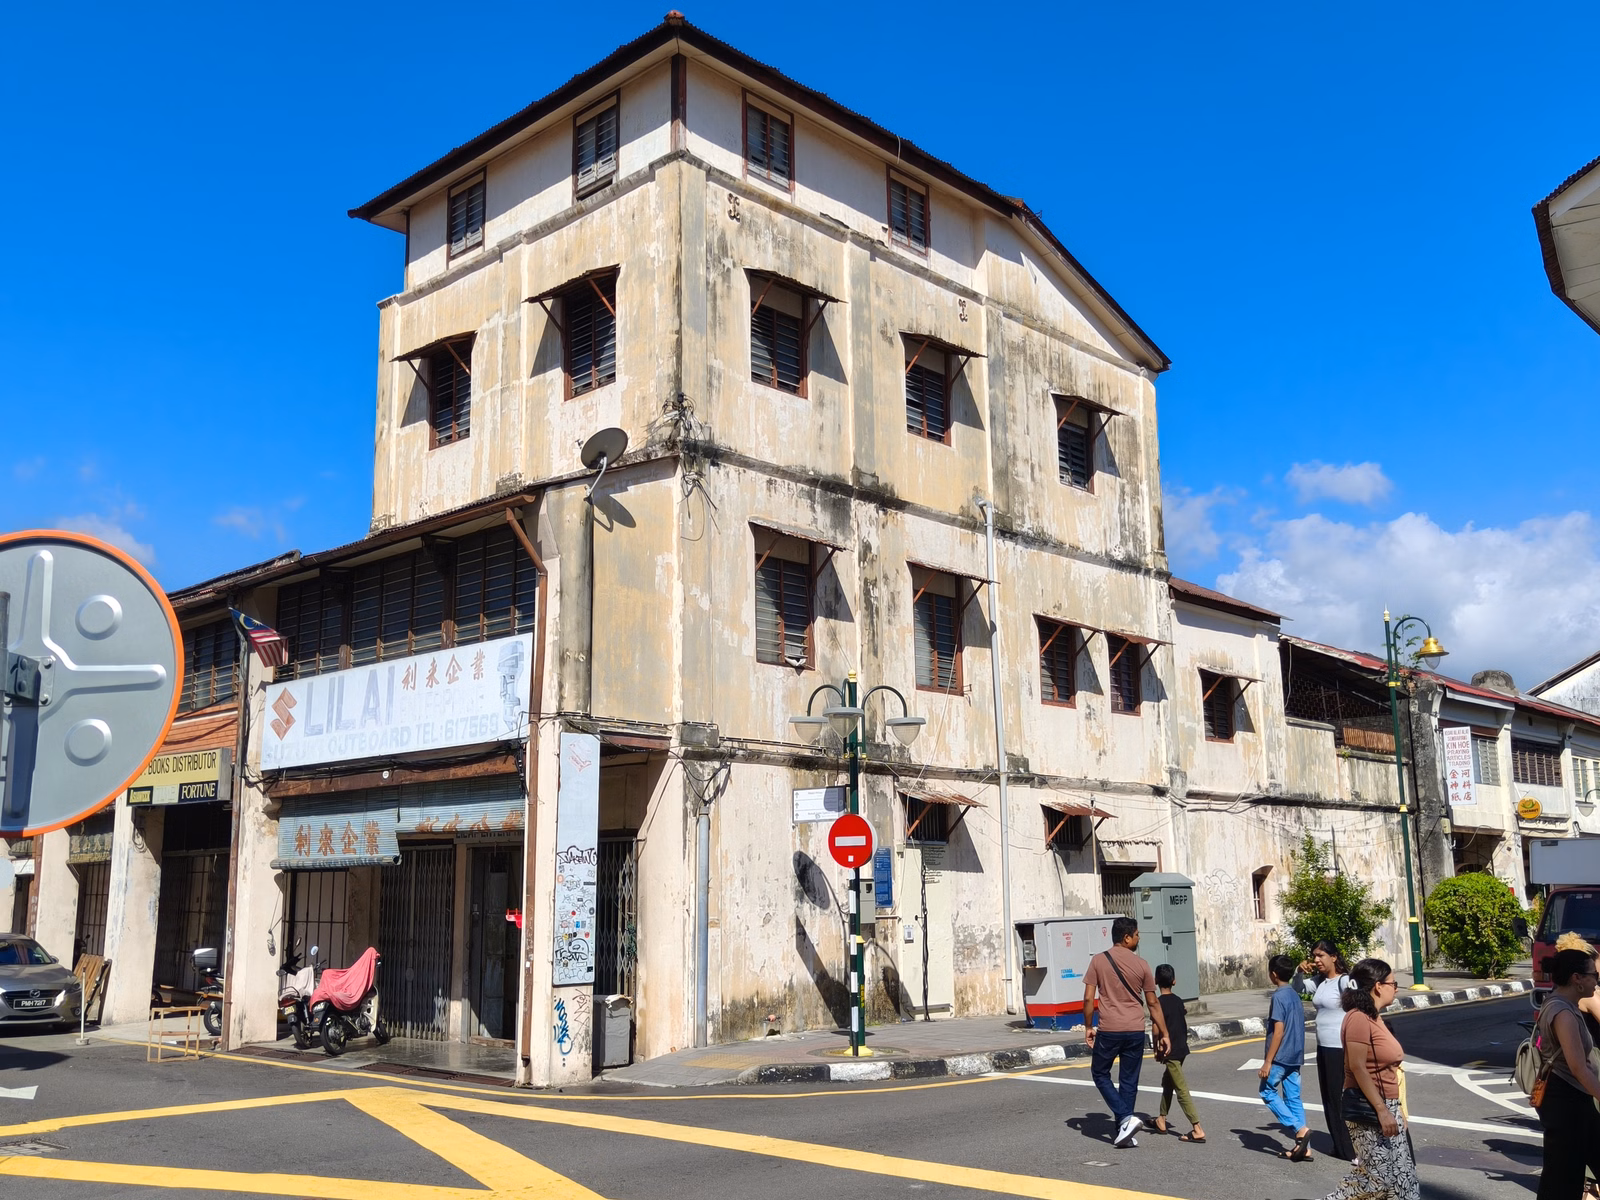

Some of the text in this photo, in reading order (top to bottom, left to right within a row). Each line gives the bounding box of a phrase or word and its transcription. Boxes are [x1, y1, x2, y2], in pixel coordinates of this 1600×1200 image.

[304, 665, 396, 737] LILAI
[328, 725, 411, 756] OUTBOARD
[1458, 741, 1470, 749] HOE
[148, 752, 217, 775] BOOKS DISTRIBUTOR
[181, 782, 216, 800] FORTUNE
